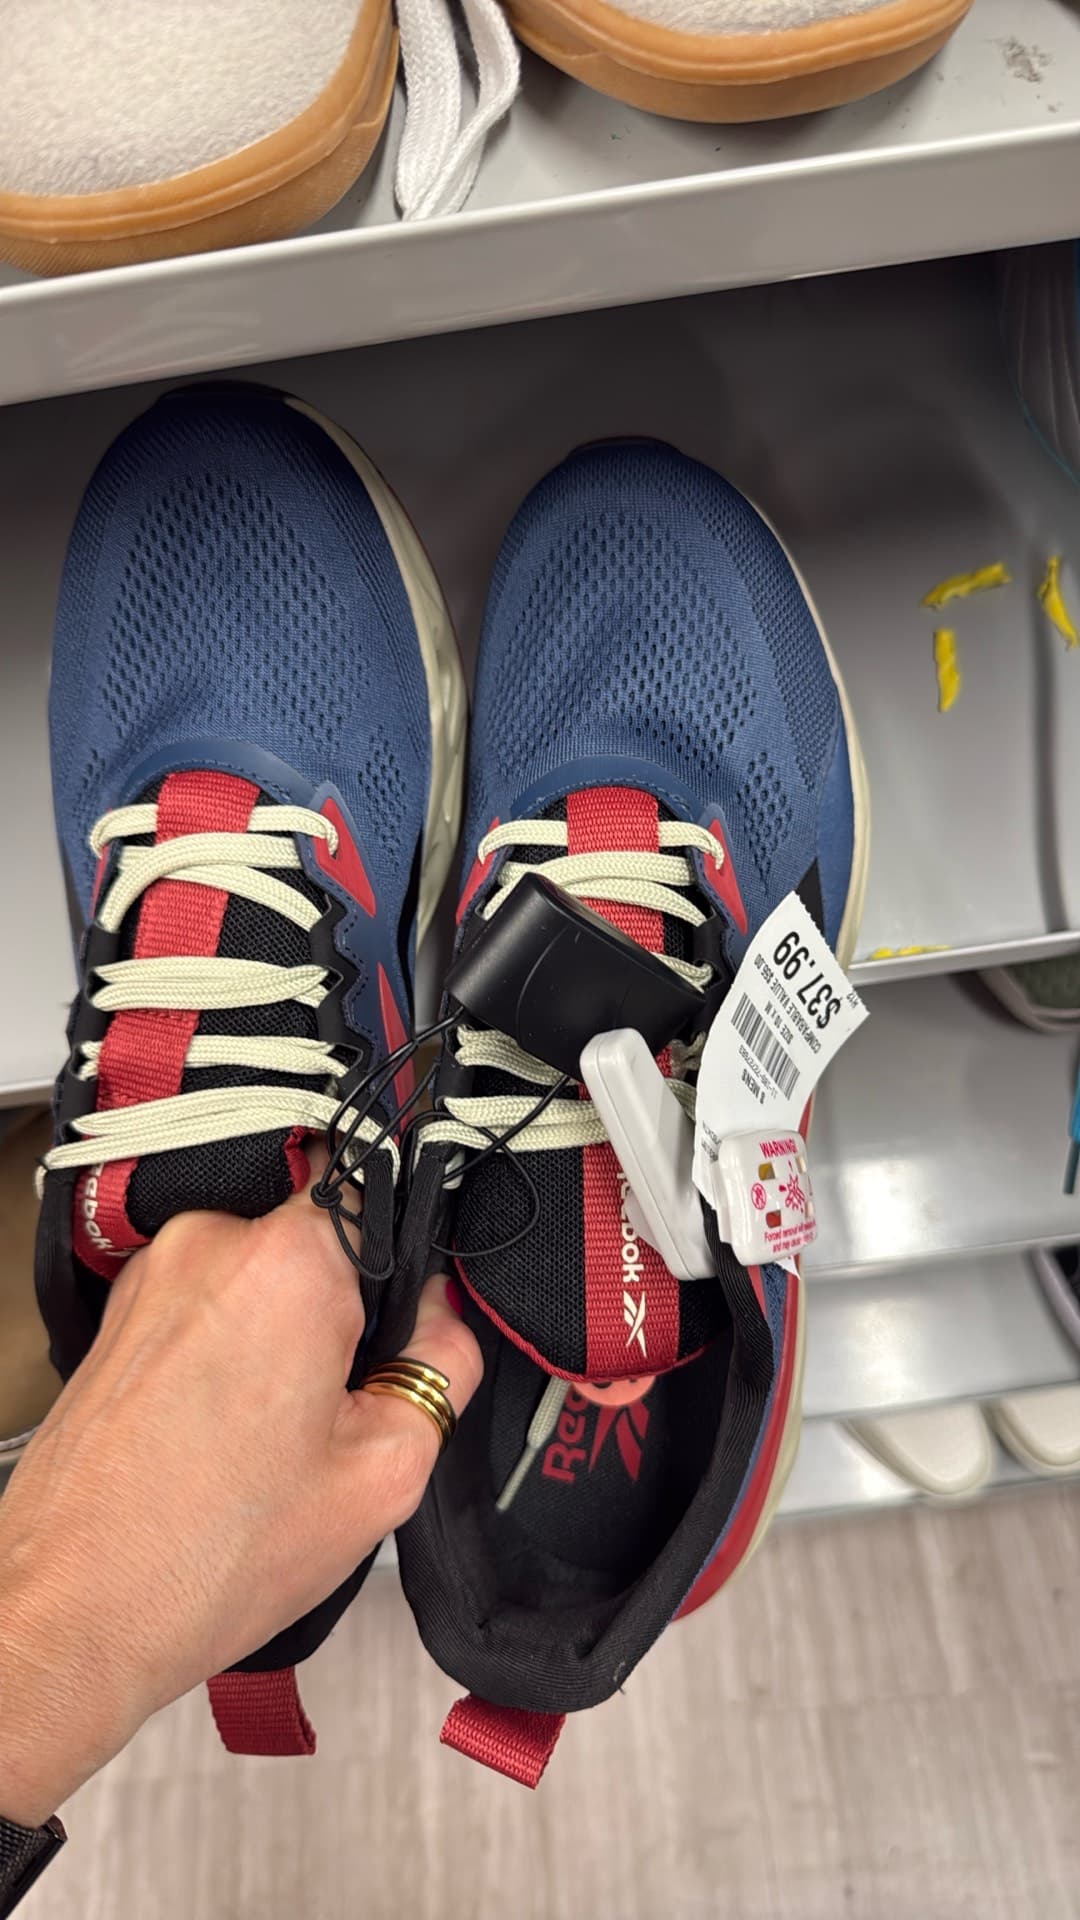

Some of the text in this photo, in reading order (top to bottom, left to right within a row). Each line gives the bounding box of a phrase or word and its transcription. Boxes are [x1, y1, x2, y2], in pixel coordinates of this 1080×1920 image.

[770, 978, 791, 1009] VALUE
[773, 931, 841, 1029] $37.99
[780, 1024, 794, 1045] SIZE
[787, 1002, 821, 1054] COMPARABLE
[741, 1068, 761, 1098] MENS
